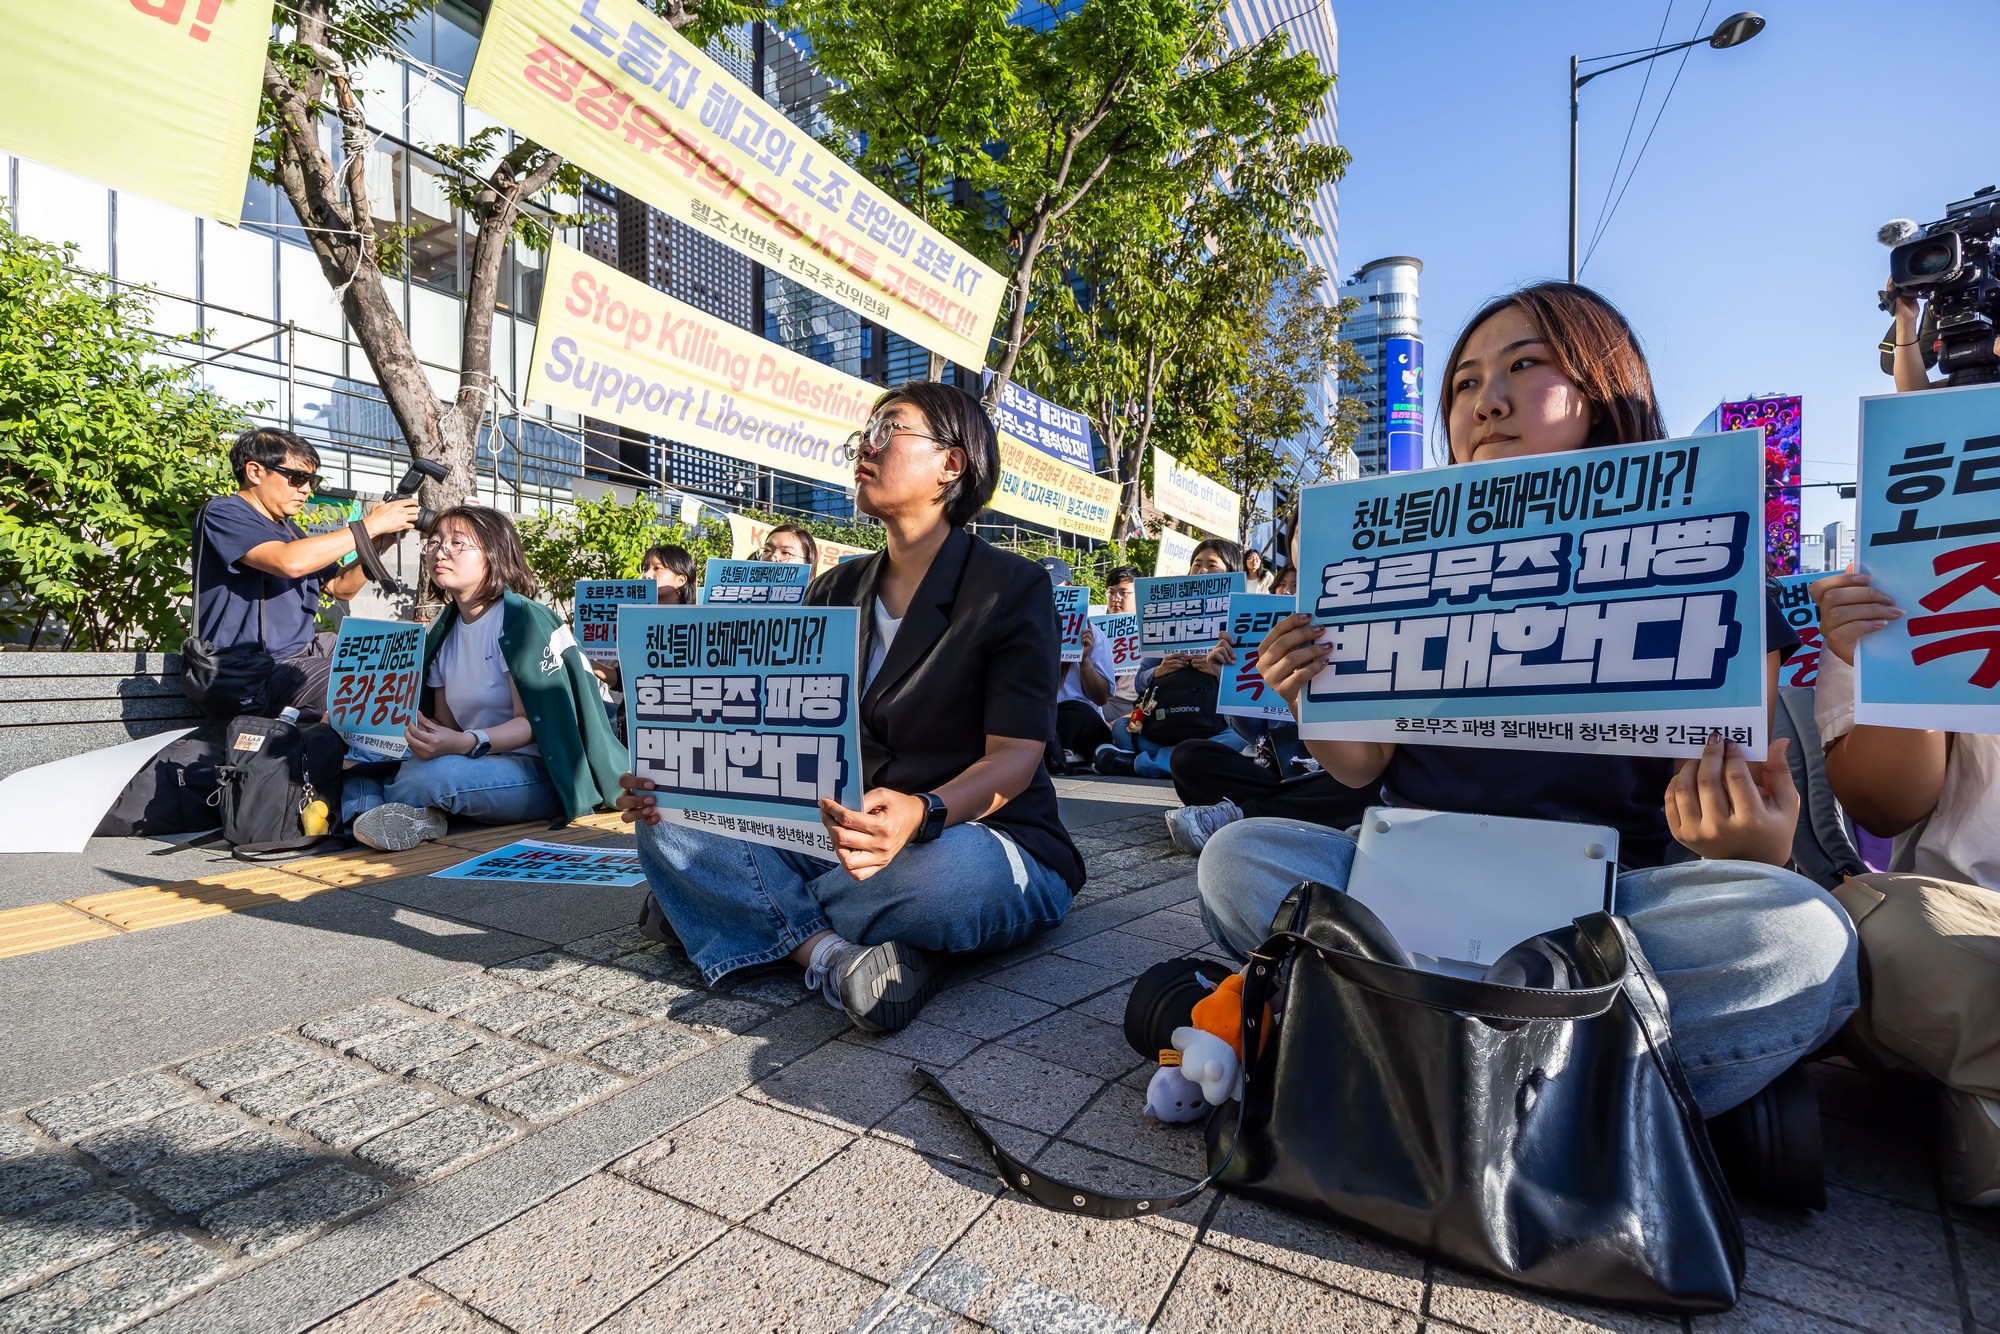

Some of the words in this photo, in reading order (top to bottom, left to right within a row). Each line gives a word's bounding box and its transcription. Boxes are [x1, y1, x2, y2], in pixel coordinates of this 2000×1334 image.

[570, 0, 701, 110] 노동자
[700, 82, 796, 177] 해고와
[792, 152, 850, 213] 노조
[846, 190, 917, 258] 탄압의
[912, 236, 956, 283] 표본
[952, 262, 983, 297] KT
[524, 34, 745, 200] 정경유착의
[741, 182, 812, 240] 온상
[810, 223, 879, 282] KT를
[880, 263, 978, 337] 규탄한다!!
[690, 198, 784, 264] 헬조선변혁
[788, 253, 890, 320] 전국추진위원회
[565, 269, 652, 350] Stop
[657, 310, 751, 392] Killing
[545, 337, 695, 421] Support
[699, 389, 830, 462] Liberation
[1001, 384, 1037, 418] 용노조
[1040, 401, 1082, 436] 물리치고
[1039, 427, 1089, 461] 쟁취하자!!
[1067, 474, 1096, 498] 민주노조
[1168, 466, 1199, 497] Hands
[1201, 487, 1214, 503] off
[1215, 492, 1232, 512] Cuba
[1352, 482, 1461, 550] 청년들이
[1466, 446, 1700, 535] 방패막이인가?!
[720, 566, 749, 583] 청년들이
[749, 566, 799, 583] 방패막이인가?!
[1318, 537, 1561, 609] 호르무즈
[1577, 516, 1736, 584] 파병
[585, 586, 624, 599] 호르무즈
[627, 585, 646, 599] 해협
[709, 585, 768, 602] 호르무즈
[769, 585, 803, 602] 파병
[1053, 590, 1080, 612] 검토
[1143, 599, 1202, 618] 호르무즈
[1150, 583, 1177, 600] 청년들이
[1179, 577, 1231, 598] 방패막이인가?!
[579, 603, 617, 621] 한국군
[583, 623, 609, 641] 절대
[333, 635, 384, 672] 호르무즈
[378, 629, 420, 671] 파병검토
[646, 622, 702, 668] 청년들이
[706, 616, 828, 667] 방패막이인가?!
[1310, 595, 1727, 695] 반대한다
[333, 672, 376, 726] 즉각
[370, 670, 420, 726] 중단!
[636, 676, 757, 717] 호르무즈
[764, 676, 843, 720] 파병
[1395, 717, 1458, 734] 호르무즈
[1461, 719, 1496, 737] 파병
[1500, 720, 1573, 741] 절대반대
[1579, 723, 1659, 744] 청년학생
[635, 728, 842, 801] 반대한다
[683, 808, 716, 825] 호르무즈
[718, 815, 736, 830] 파병
[737, 818, 774, 838] 절대반대
[776, 825, 814, 845] 청년학생
